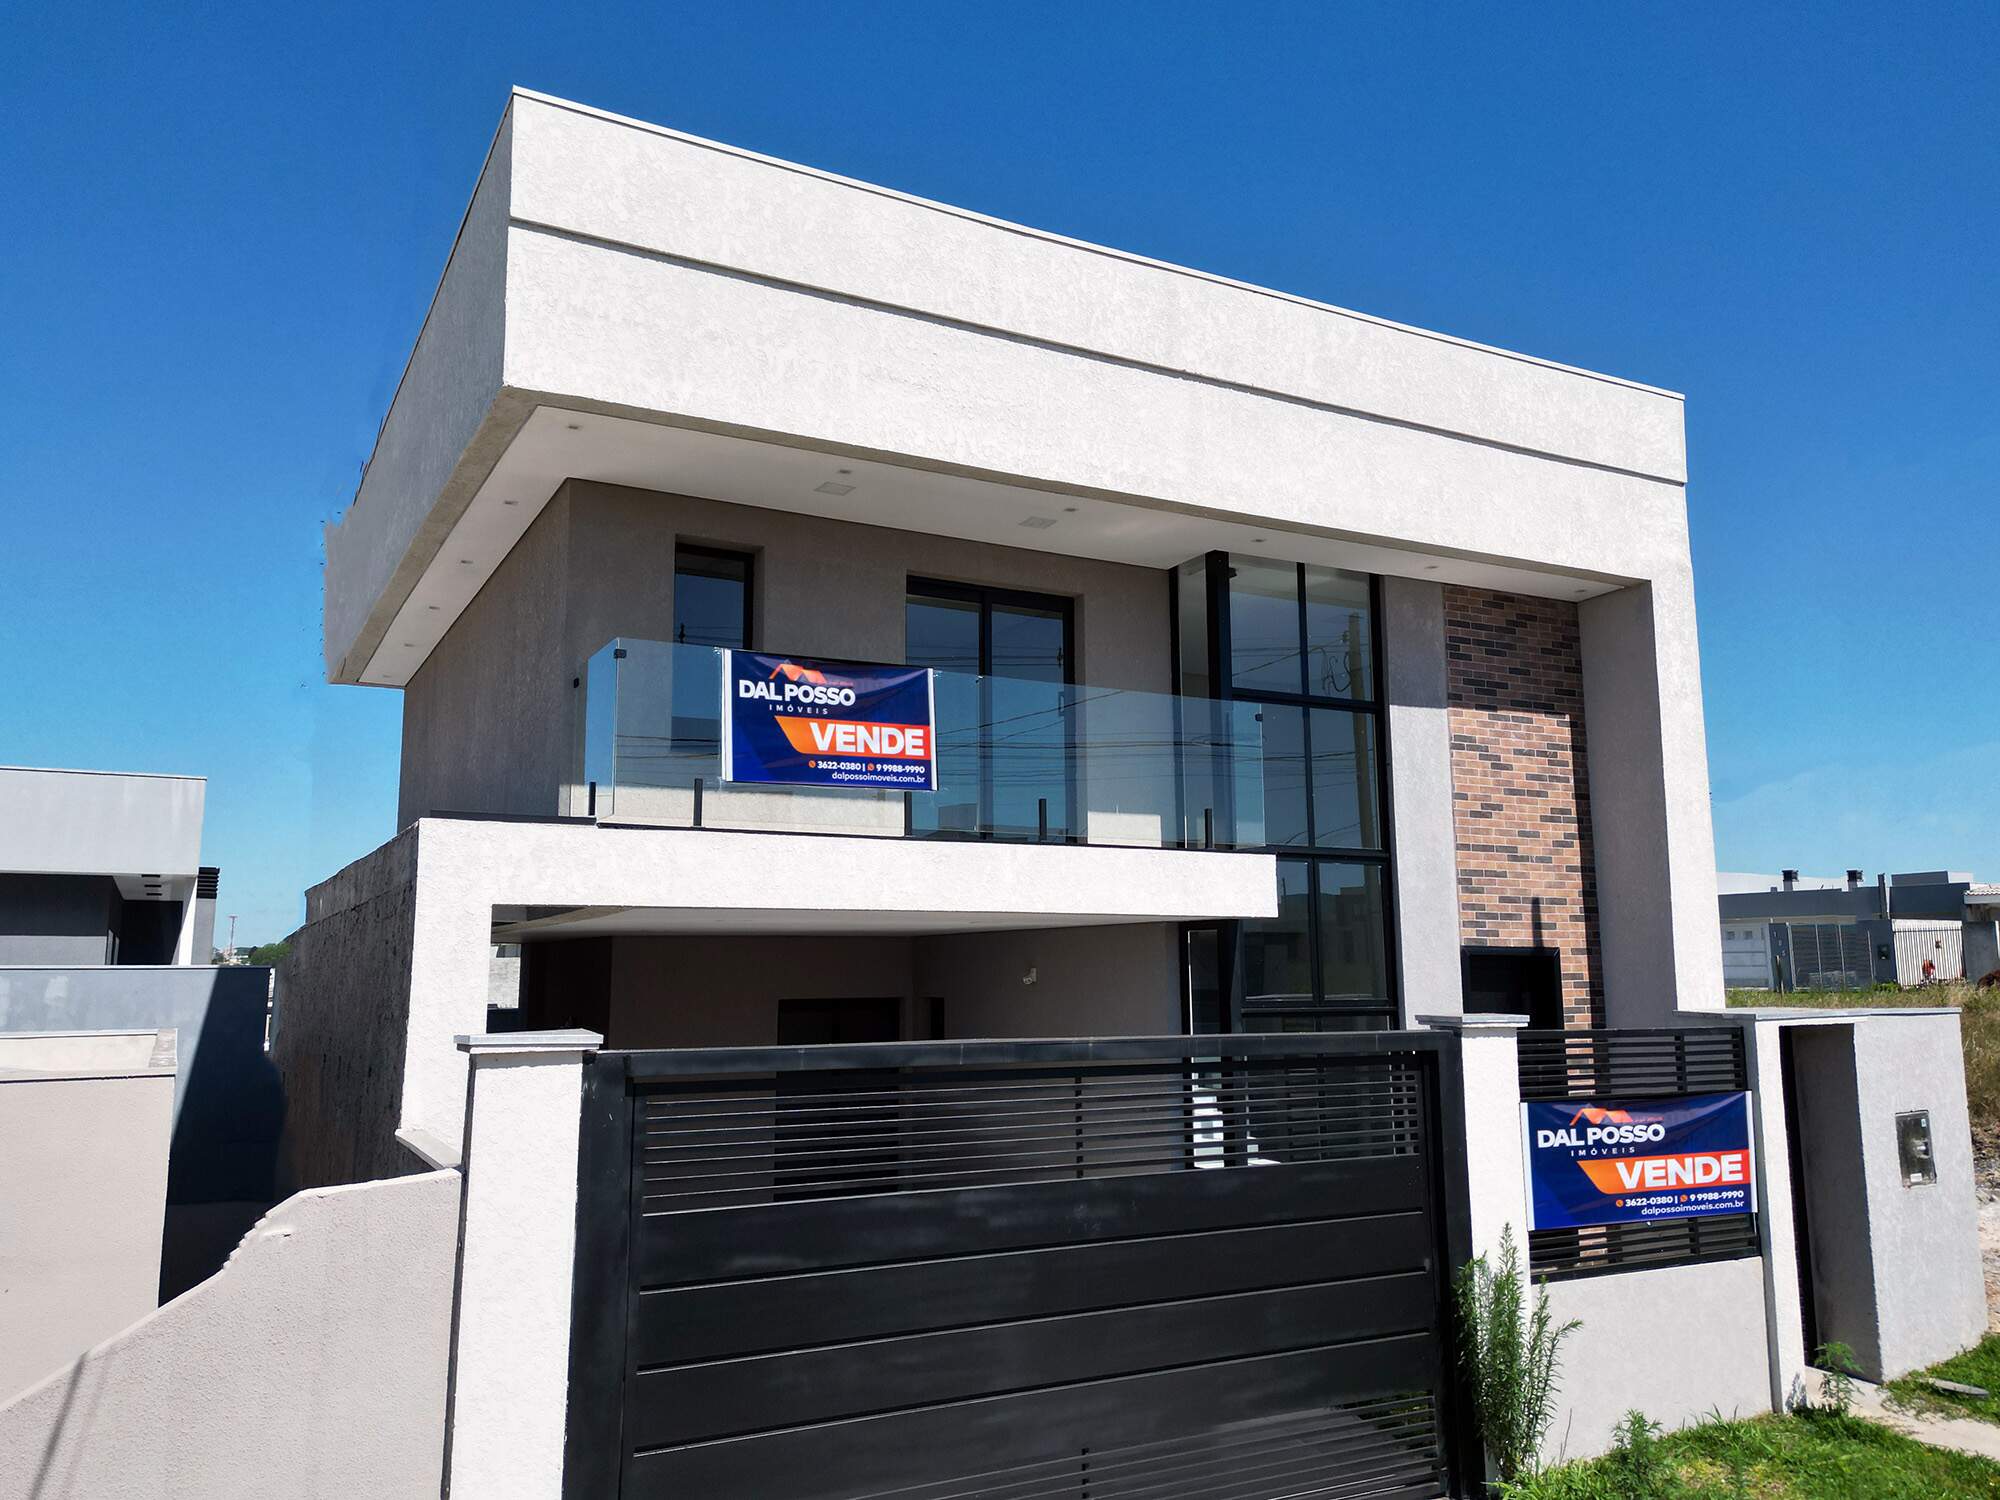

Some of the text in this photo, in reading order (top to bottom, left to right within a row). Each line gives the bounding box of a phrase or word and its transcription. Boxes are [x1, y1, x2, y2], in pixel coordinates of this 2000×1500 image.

[739, 680, 856, 706] DAL POSSO
[769, 704, 829, 715] IMÓVEIS
[809, 722, 925, 757] VENDE
[831, 771, 926, 784] dalpossoimoveis.com.br
[1537, 1123, 1666, 1149] DAL POSSO
[1571, 1146, 1635, 1157] IMÓVEIS
[1615, 1153, 1744, 1190] VENDE
[1641, 1199, 1745, 1216] dalpossoimoveis.com.br
